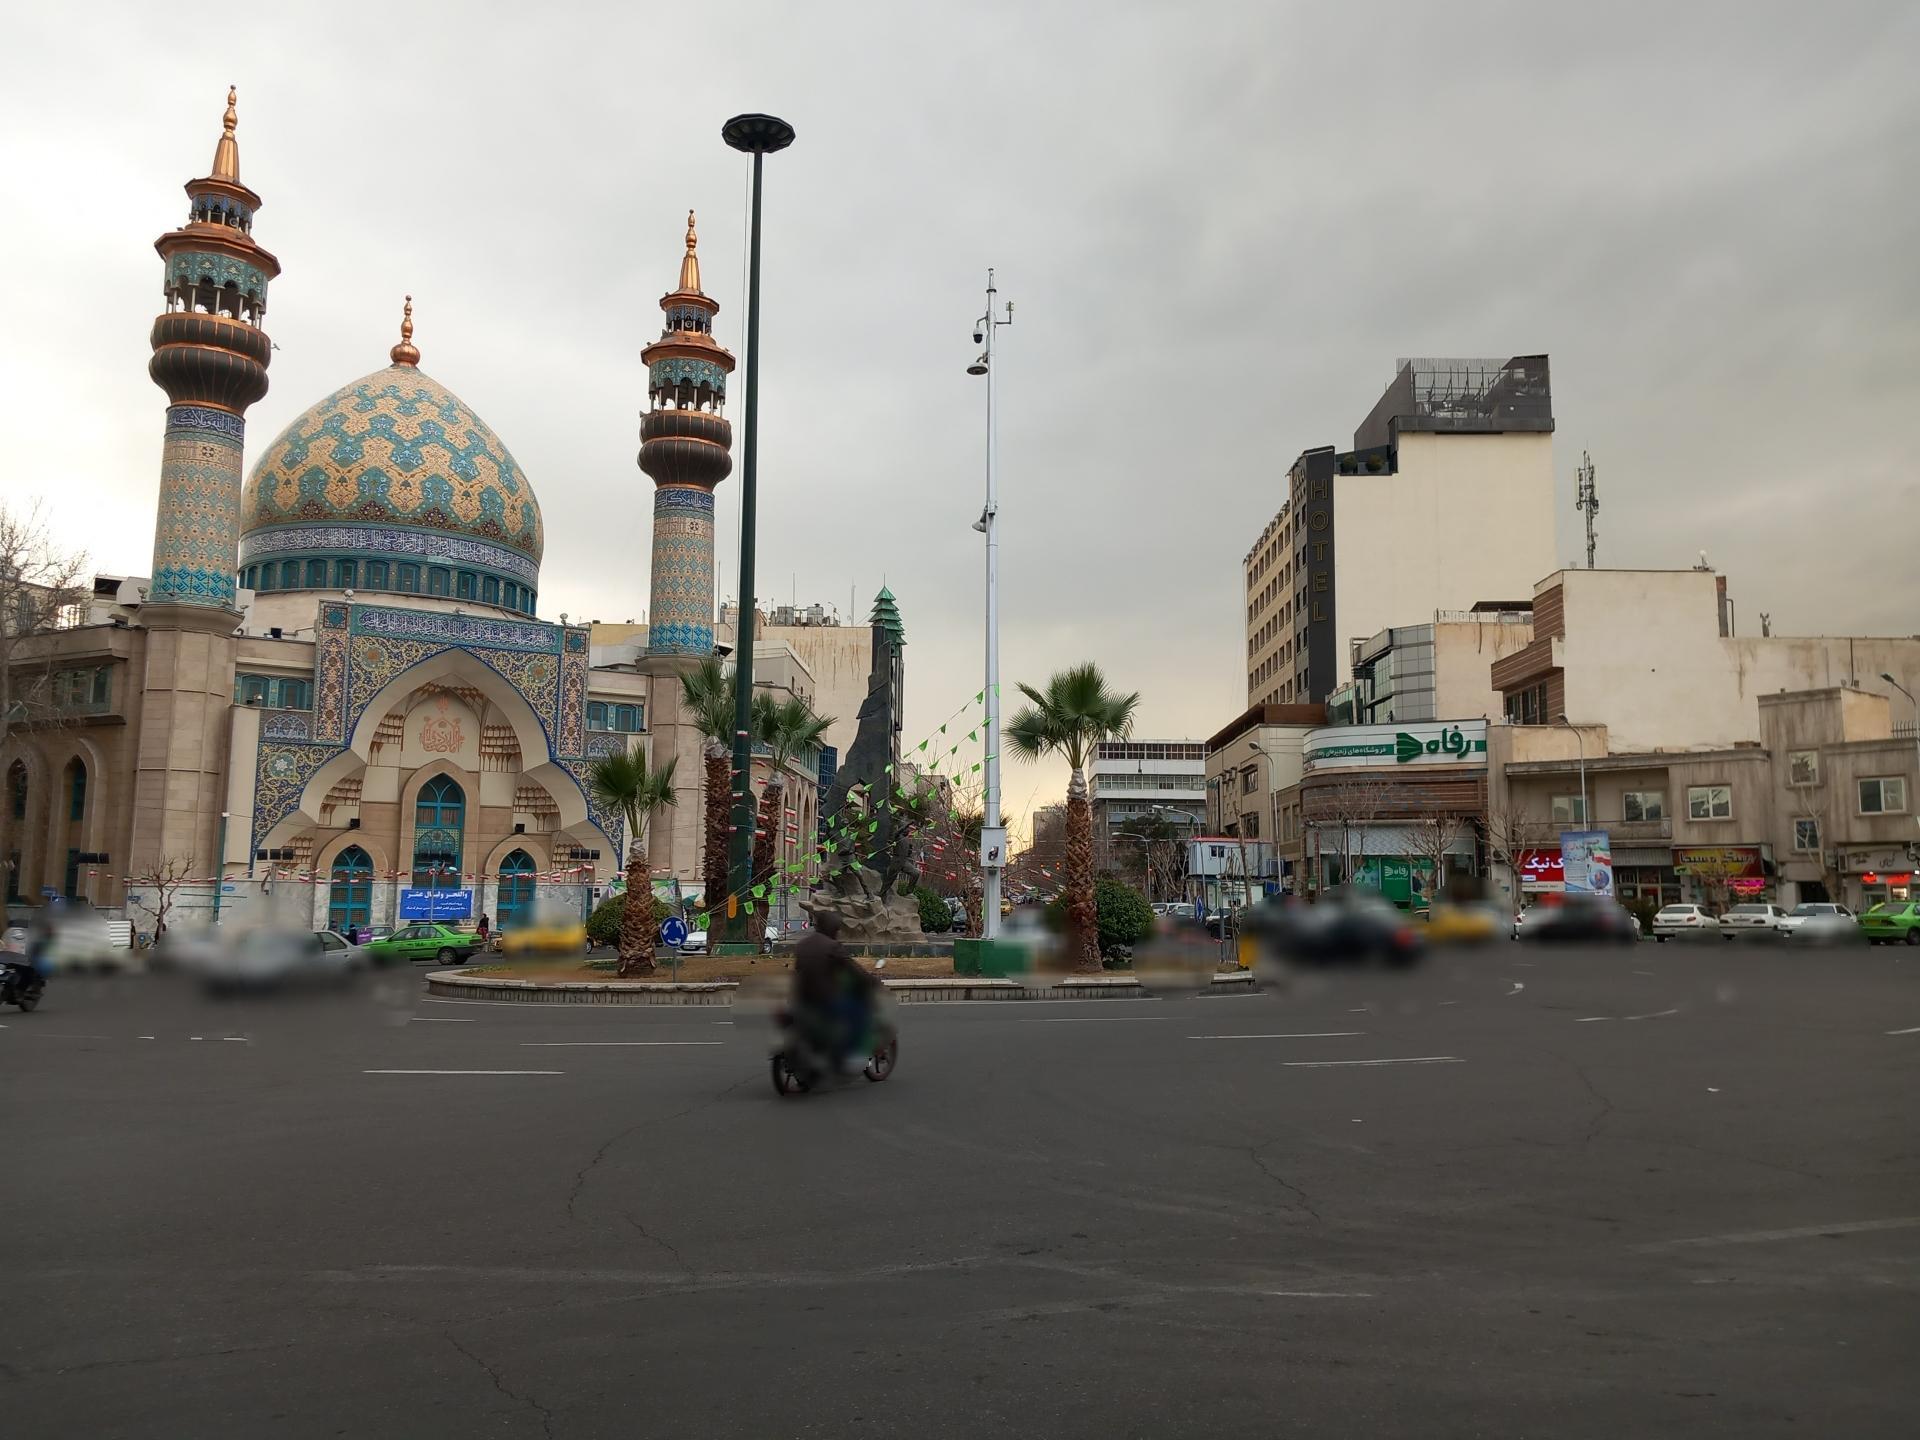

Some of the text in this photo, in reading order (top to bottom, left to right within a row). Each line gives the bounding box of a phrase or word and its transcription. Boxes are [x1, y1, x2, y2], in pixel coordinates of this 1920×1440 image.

[1310, 479, 1329, 621] HOTEL
[1426, 725, 1471, 759] رفاه
[1394, 865, 1409, 877] رفاه
[1524, 857, 1550, 873] نیک
